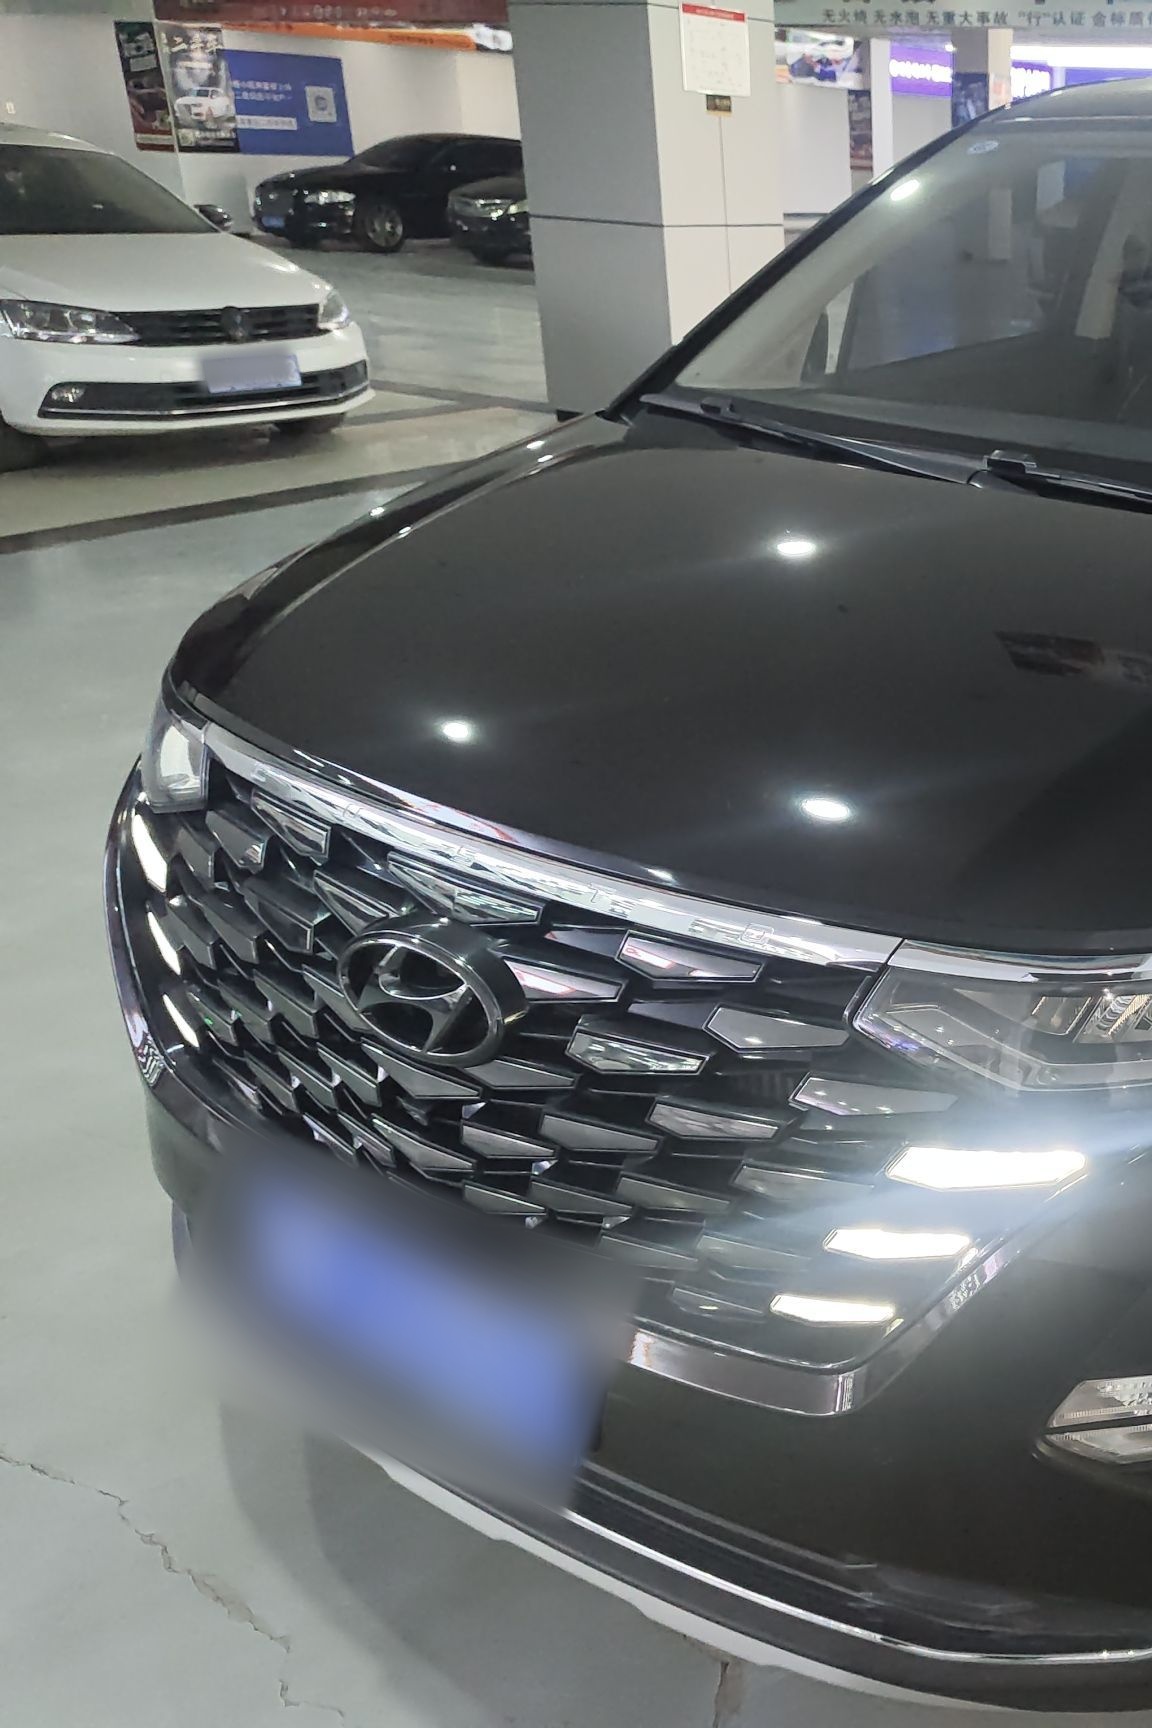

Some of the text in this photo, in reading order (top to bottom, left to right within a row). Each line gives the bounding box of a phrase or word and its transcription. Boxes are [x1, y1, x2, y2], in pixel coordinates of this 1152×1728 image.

[874, 10, 920, 25] 无水泡
[926, 11, 1008, 26] 无重大事故
